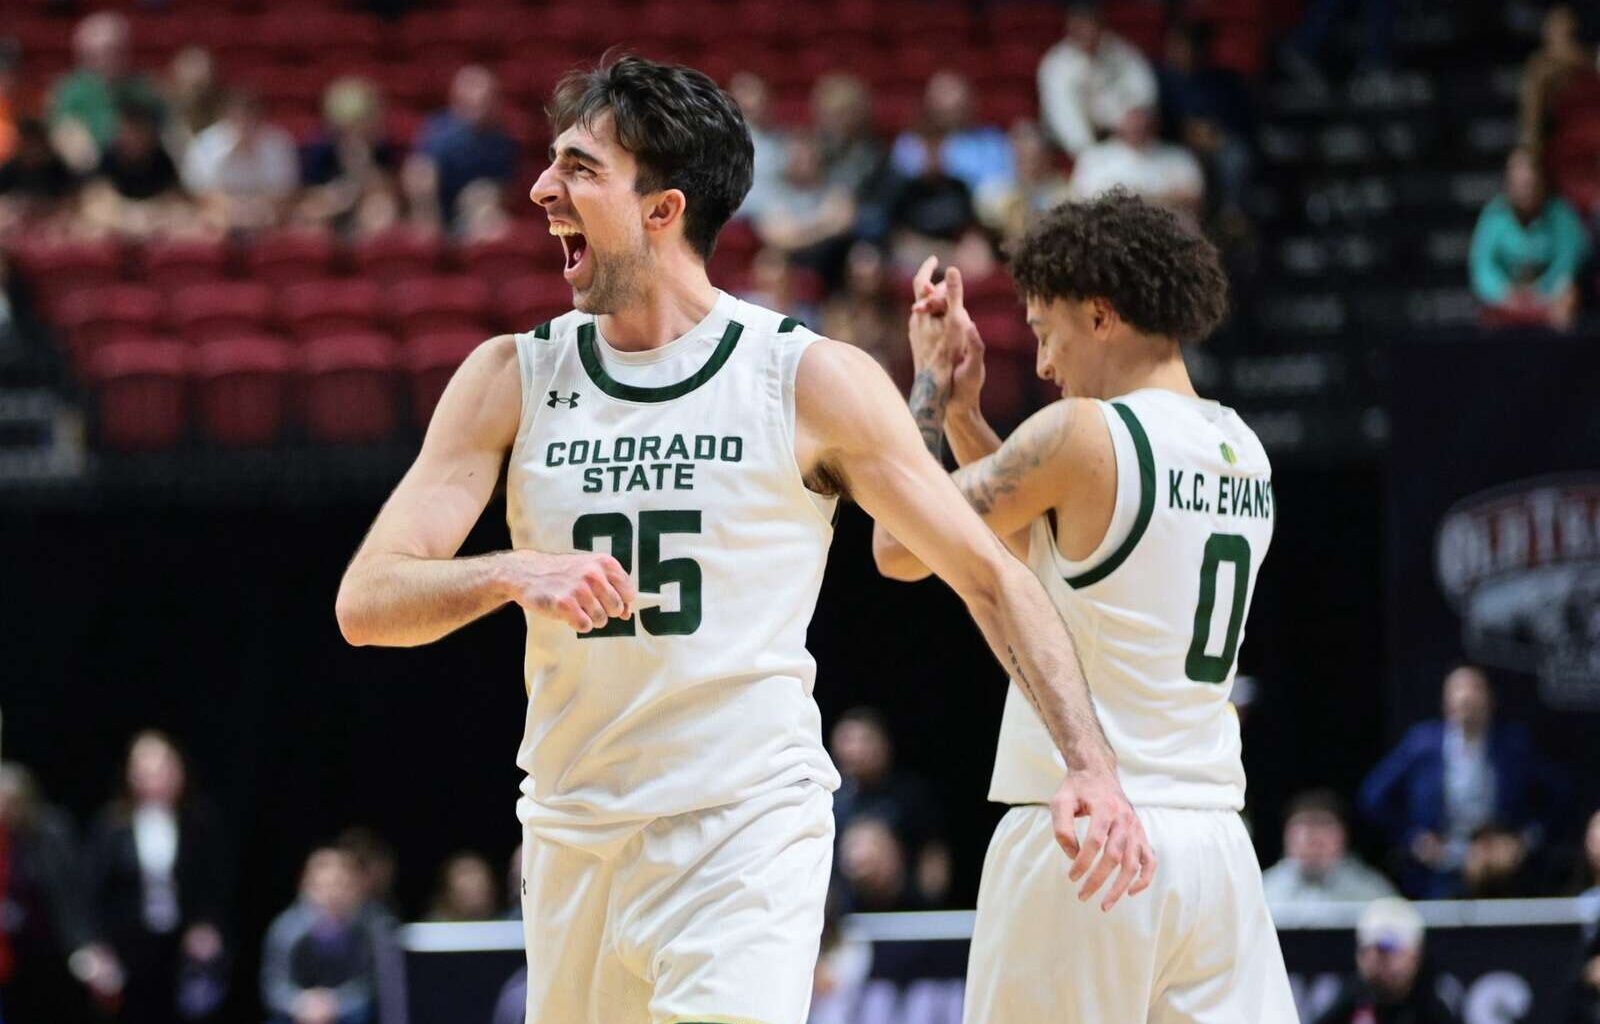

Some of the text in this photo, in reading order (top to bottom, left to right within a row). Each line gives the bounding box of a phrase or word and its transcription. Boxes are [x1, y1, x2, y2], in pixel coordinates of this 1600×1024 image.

[545, 434, 743, 467] COLORADO
[582, 464, 695, 493] STATE
[1168, 469, 1271, 519] K.C. EVANS
[572, 510, 702, 639] 25
[1185, 532, 1251, 684] 0
